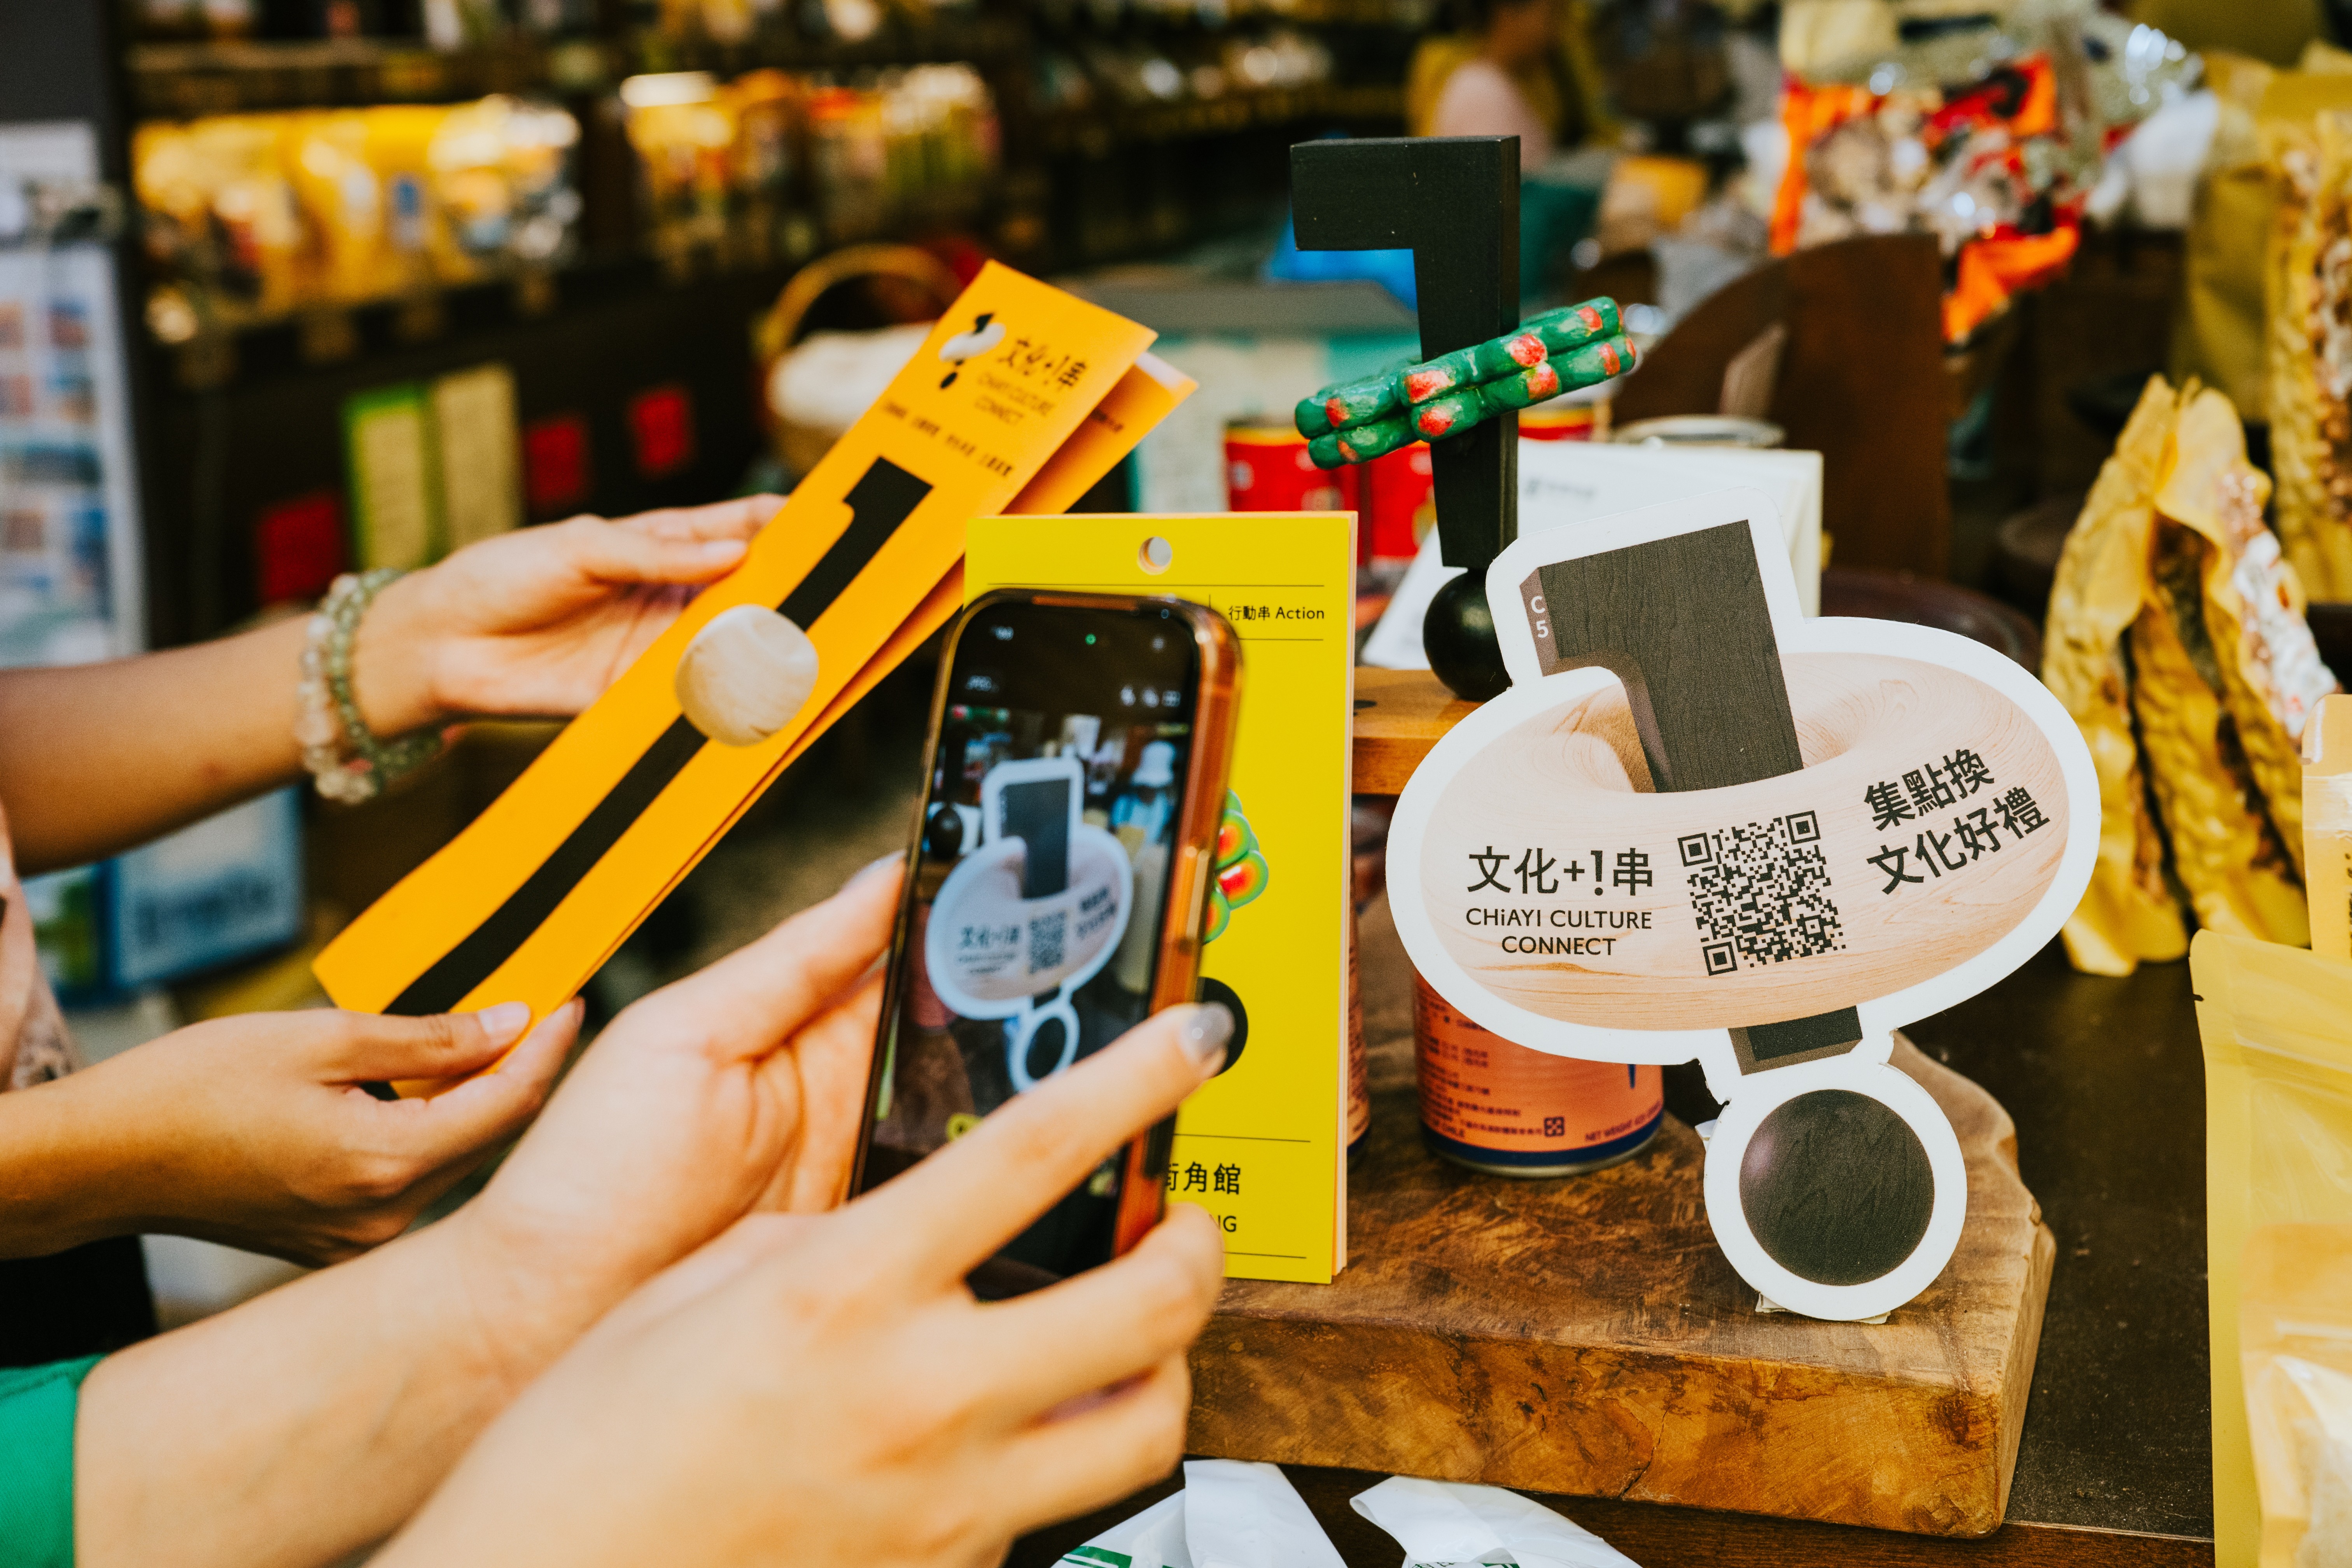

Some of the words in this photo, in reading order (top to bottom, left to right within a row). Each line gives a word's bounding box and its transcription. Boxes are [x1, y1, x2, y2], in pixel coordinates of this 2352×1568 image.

[1228, 606, 1270, 621] 行動串
[1276, 607, 1324, 619] Action
[1864, 749, 1994, 831] 集點換
[1866, 787, 2050, 895] 文化好禮
[1466, 908, 1541, 927] CHiAYI
[1550, 910, 1652, 929] CULTURE
[1502, 936, 1616, 956] CONNECT
